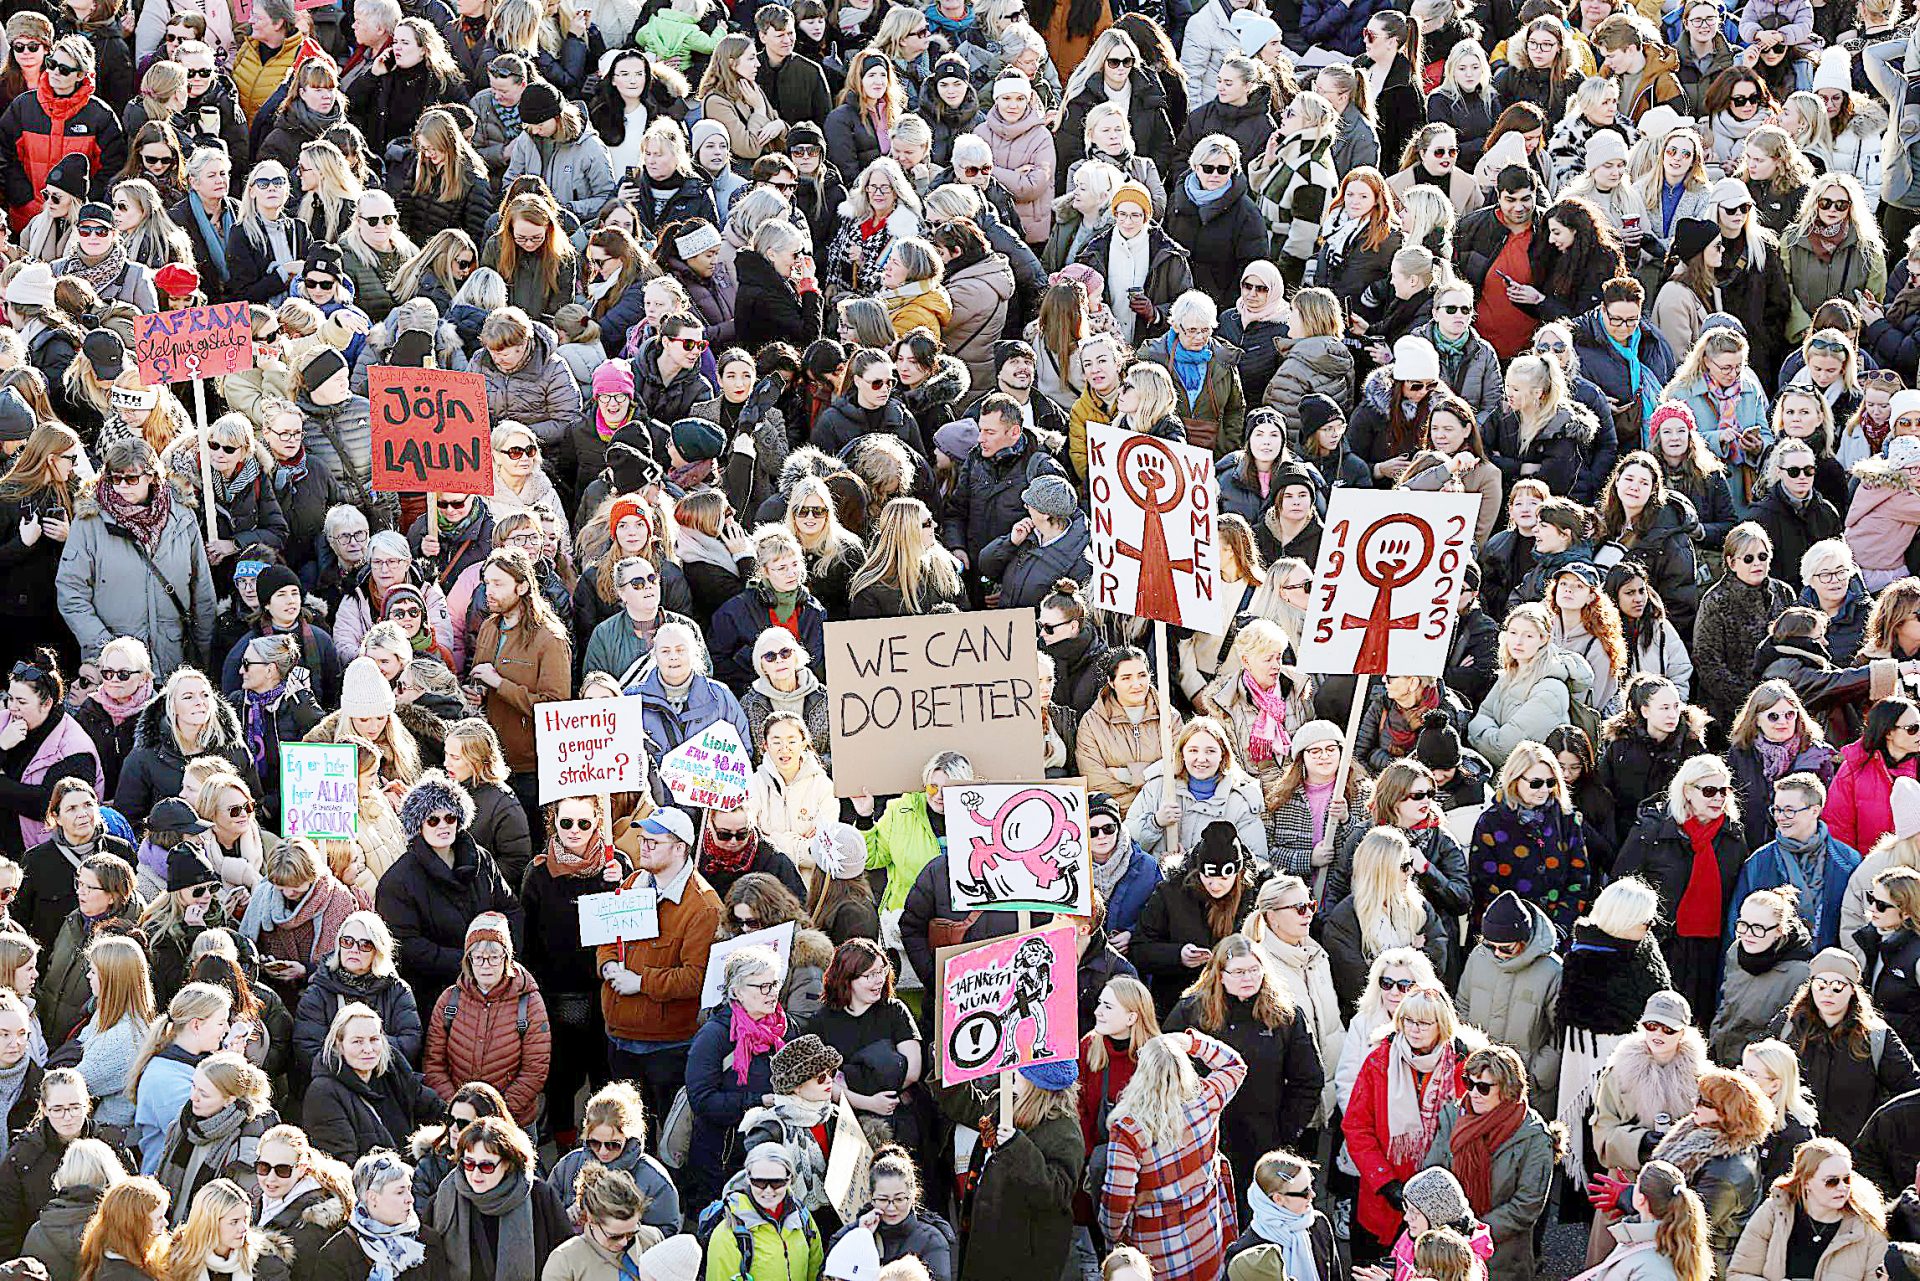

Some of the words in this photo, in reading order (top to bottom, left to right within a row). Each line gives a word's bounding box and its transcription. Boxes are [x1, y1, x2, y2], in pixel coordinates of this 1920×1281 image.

[384, 436, 480, 481] LAUN
[1091, 437, 1119, 606] KONUR
[1184, 455, 1213, 601] WOMEN
[1313, 519, 1350, 643] 1975
[1424, 515, 1466, 640] 2023
[847, 634, 909, 678] WE
[925, 620, 1013, 667] CAN
[545, 708, 616, 735] Hvernig
[841, 686, 902, 737] DO
[911, 679, 1036, 731] BETTER
[287, 748, 303, 782] Ég
[557, 737, 613, 763] gengur
[712, 754, 730, 771] 48
[557, 753, 629, 786] strákar?
[317, 780, 356, 807] ALLAR
[301, 809, 355, 839] KONUR
[949, 964, 1012, 1001] JAFNRÉTTI
[959, 990, 1001, 1014] NÚNA
